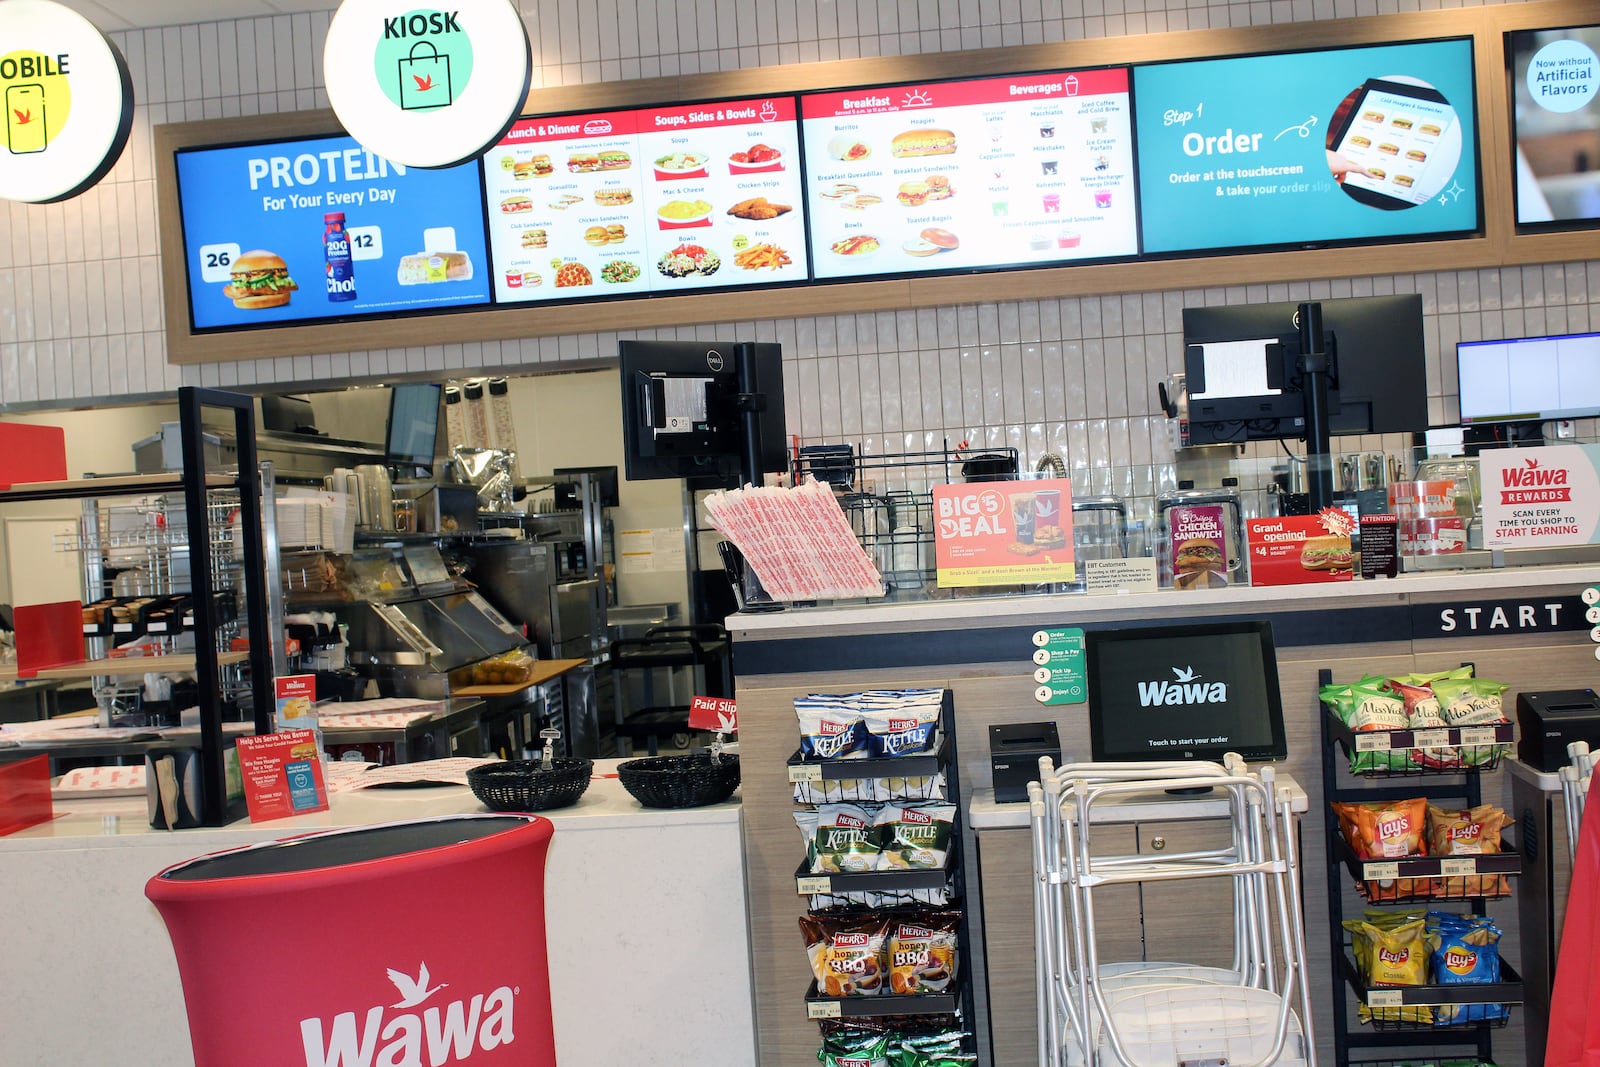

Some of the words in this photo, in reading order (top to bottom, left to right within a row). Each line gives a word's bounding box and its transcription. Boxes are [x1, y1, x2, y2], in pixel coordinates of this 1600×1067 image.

[383, 11, 461, 39] KIOSK
[1536, 60, 1556, 68] Now
[1559, 57, 1592, 66] without
[1536, 67, 1592, 82] Artificial
[1009, 82, 1062, 96] Beverages
[1541, 84, 1588, 96] Flavors
[843, 96, 890, 109] Breakfast
[655, 115, 687, 127] Soups,
[688, 112, 715, 123] Sides
[716, 110, 725, 121] &
[726, 107, 756, 120] Bowls
[1163, 109, 1194, 127] Step
[1196, 103, 1203, 118] 1
[834, 124, 859, 132] Burritos
[910, 118, 936, 126] Hoagies
[507, 127, 537, 139] Lunch
[538, 126, 546, 136] &
[547, 123, 581, 136] Dinner
[1033, 144, 1066, 152] Milkshakes
[1182, 128, 1263, 157] Order
[817, 173, 846, 182] Breakfast
[847, 170, 883, 179] Quesadillas
[893, 167, 923, 175] Breakfast
[924, 164, 960, 173] Sandwiches
[1169, 173, 1201, 184] Order
[1203, 171, 1215, 181] at
[1216, 168, 1235, 180] the
[1237, 164, 1304, 178] touchscreen
[548, 183, 578, 191] Quesadillas
[683, 186, 705, 194] Cheese
[737, 182, 761, 190] Chicken
[762, 180, 780, 188] Strips
[1215, 186, 1224, 196] &
[1226, 184, 1250, 196] take
[1252, 184, 1277, 198] your
[1280, 182, 1310, 193] order
[1312, 180, 1331, 193] slip
[263, 196, 285, 211] For
[289, 193, 322, 209] Your
[326, 190, 364, 206] Every
[368, 187, 397, 206] Day
[524, 220, 552, 228] Sandwiches
[599, 214, 629, 222] Sandwiches
[906, 216, 930, 224] Toasted
[931, 214, 952, 223] Bagels
[326, 241, 347, 251] 20G
[353, 234, 374, 249] 12
[206, 252, 230, 268] 26
[1502, 467, 1568, 488] Wawa
[1508, 490, 1564, 502] REWARDS
[938, 494, 980, 517] BIG
[982, 494, 999, 513] $5
[1190, 514, 1214, 525] Crispy
[1328, 511, 1351, 525] ENDS
[1512, 510, 1534, 518] SCAN
[1536, 508, 1561, 517] EVERY
[938, 516, 1007, 539] DEAL
[1178, 521, 1217, 532] CHICKEN
[1252, 522, 1283, 534] Grand
[1320, 514, 1352, 533] SUNDAY
[1499, 519, 1519, 527] TIME
[1520, 518, 1538, 526] YOU
[1540, 517, 1562, 525] SHOP
[1563, 516, 1576, 524] TO
[1174, 530, 1222, 541] SANDWICH
[1263, 530, 1307, 543] opening!
[1495, 527, 1528, 538] START
[1530, 525, 1578, 536] EARNING
[1440, 603, 1563, 632] START
[1137, 681, 1227, 707] Wawa
[693, 699, 717, 710] Paid
[718, 701, 737, 715] Slip
[1415, 706, 1438, 719] Miss
[1447, 706, 1471, 721] Miss
[822, 723, 847, 734] HERR'S
[891, 719, 917, 731] HERR'S
[239, 738, 254, 746] Help
[813, 731, 855, 757] KETTLE
[882, 729, 926, 754] KETTLE
[1148, 739, 1169, 747] Touch
[1194, 738, 1209, 746] your
[1210, 735, 1229, 743] order
[838, 816, 862, 828] HERR'S
[903, 810, 930, 823] HERR'S
[1378, 816, 1409, 840] Lay's
[1451, 824, 1480, 840] Lay's
[825, 830, 868, 851] KETTLE
[892, 825, 937, 846] KETTLE
[901, 927, 930, 938] HERR'S
[837, 934, 866, 945] HERR'S
[899, 942, 927, 951] honey
[834, 950, 863, 959] honey
[894, 951, 930, 967] BBQ
[1380, 948, 1408, 965] Lay's
[1446, 951, 1474, 968] Lay's
[830, 958, 866, 973] BBQ
[300, 985, 515, 1067] Wawa
